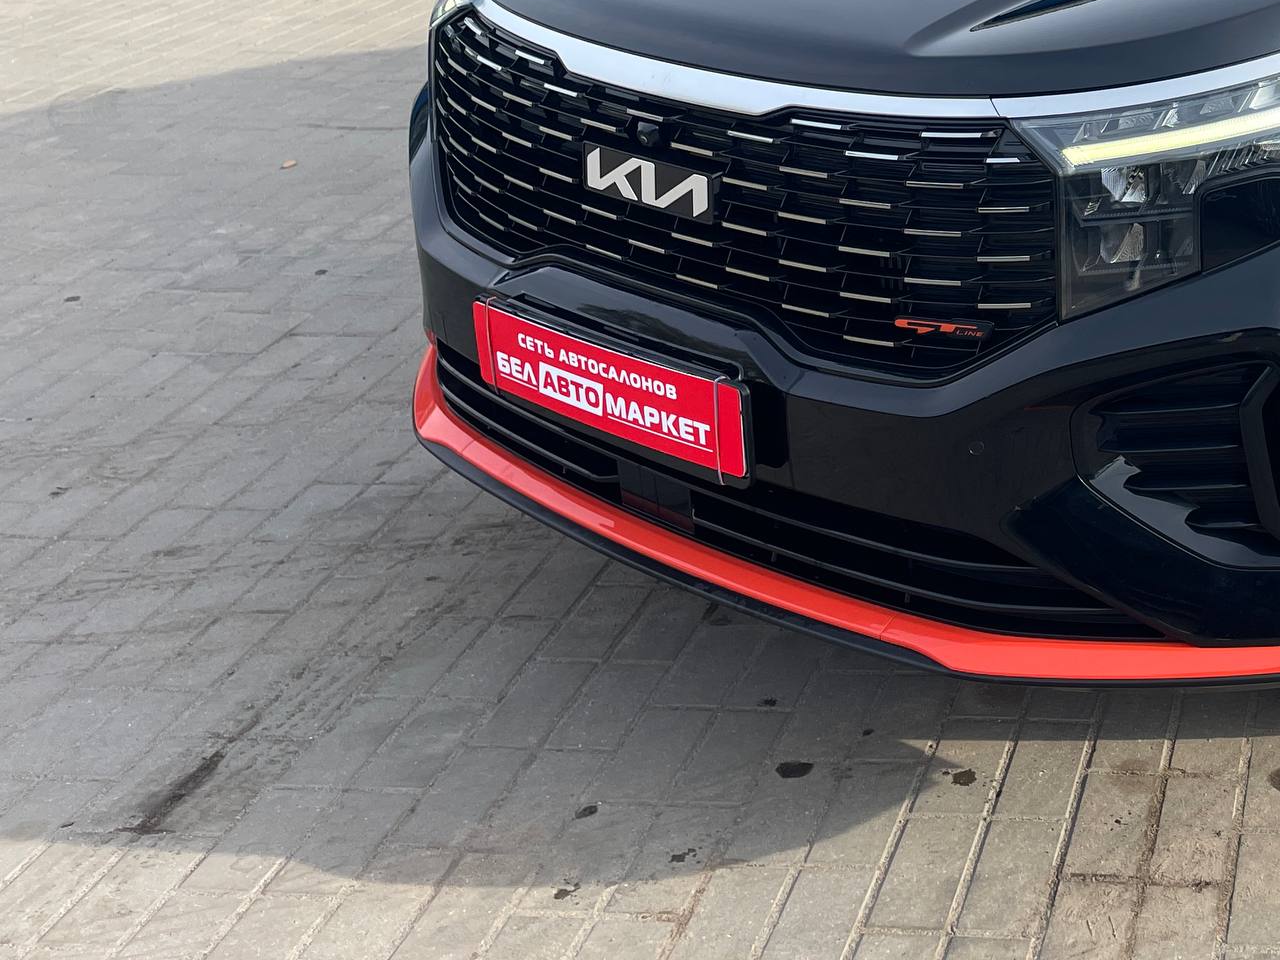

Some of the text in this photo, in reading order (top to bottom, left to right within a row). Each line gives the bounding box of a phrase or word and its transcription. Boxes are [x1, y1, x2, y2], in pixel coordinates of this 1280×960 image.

[496, 351, 711, 445] БЕЛ АВТО МАРКЕТ
[517, 332, 677, 400] СЕТЬ АВТОСАЛОНОВ
